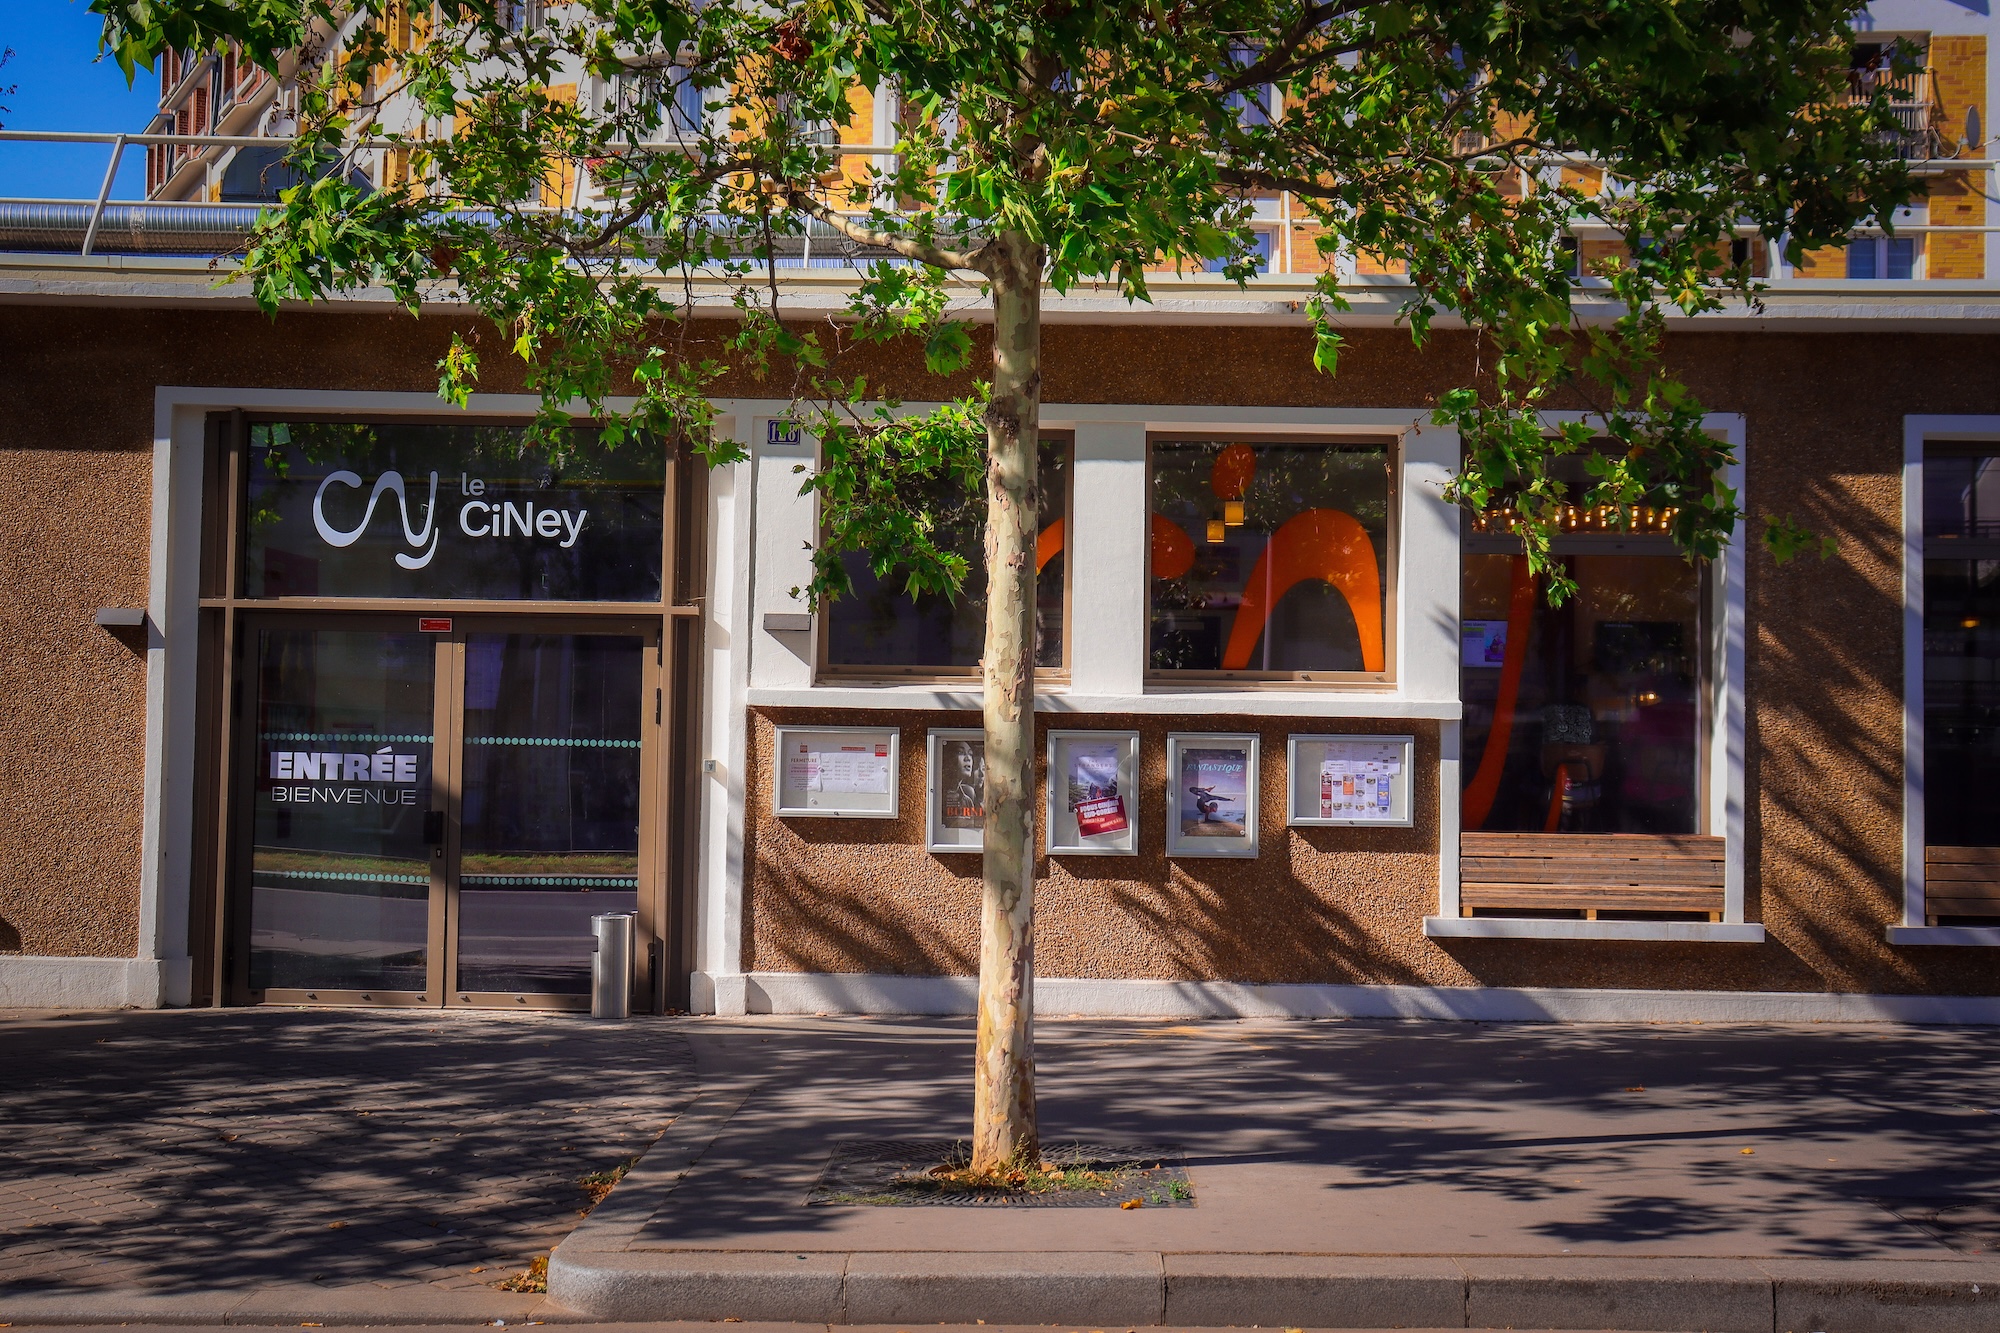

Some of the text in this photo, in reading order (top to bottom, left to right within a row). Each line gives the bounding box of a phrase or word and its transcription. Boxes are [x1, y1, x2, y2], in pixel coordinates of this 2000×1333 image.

[461, 471, 485, 497] le
[460, 500, 588, 548] CiNey
[269, 745, 418, 783] ENTRÉE
[1186, 763, 1243, 773] FANTASTIQUE
[271, 786, 417, 805] BIENVENUE
